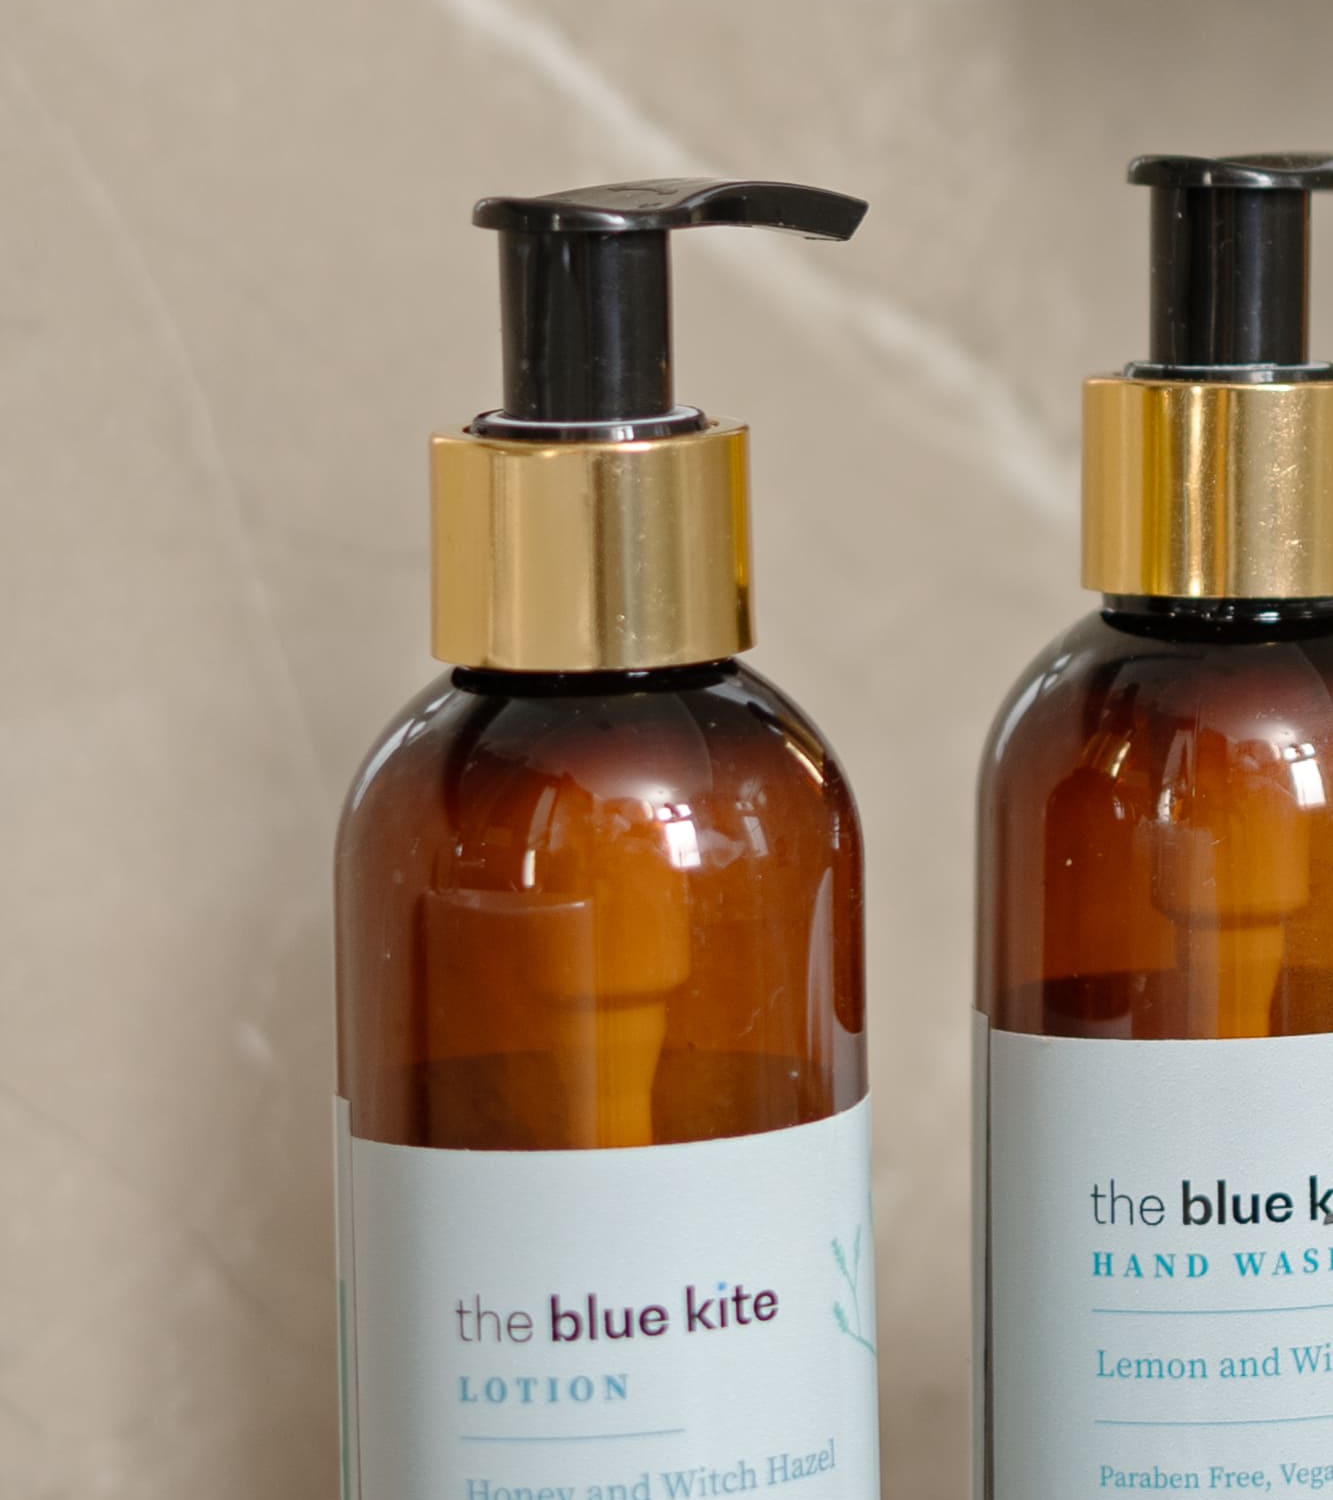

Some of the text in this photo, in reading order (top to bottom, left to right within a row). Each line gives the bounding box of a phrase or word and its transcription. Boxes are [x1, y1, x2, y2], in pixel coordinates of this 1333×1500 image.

[1090, 1179, 1165, 1226] the
[1182, 1179, 1293, 1225] blue
[1092, 1251, 1211, 1278] HAND
[454, 1282, 779, 1343] the blue kite
[1096, 1348, 1208, 1380] Lemon
[1219, 1347, 1281, 1379] and
[458, 1373, 630, 1404] LOTION
[765, 1438, 838, 1486] Hazel
[1099, 1466, 1201, 1489] Paraben
[1209, 1466, 1273, 1492] Free,
